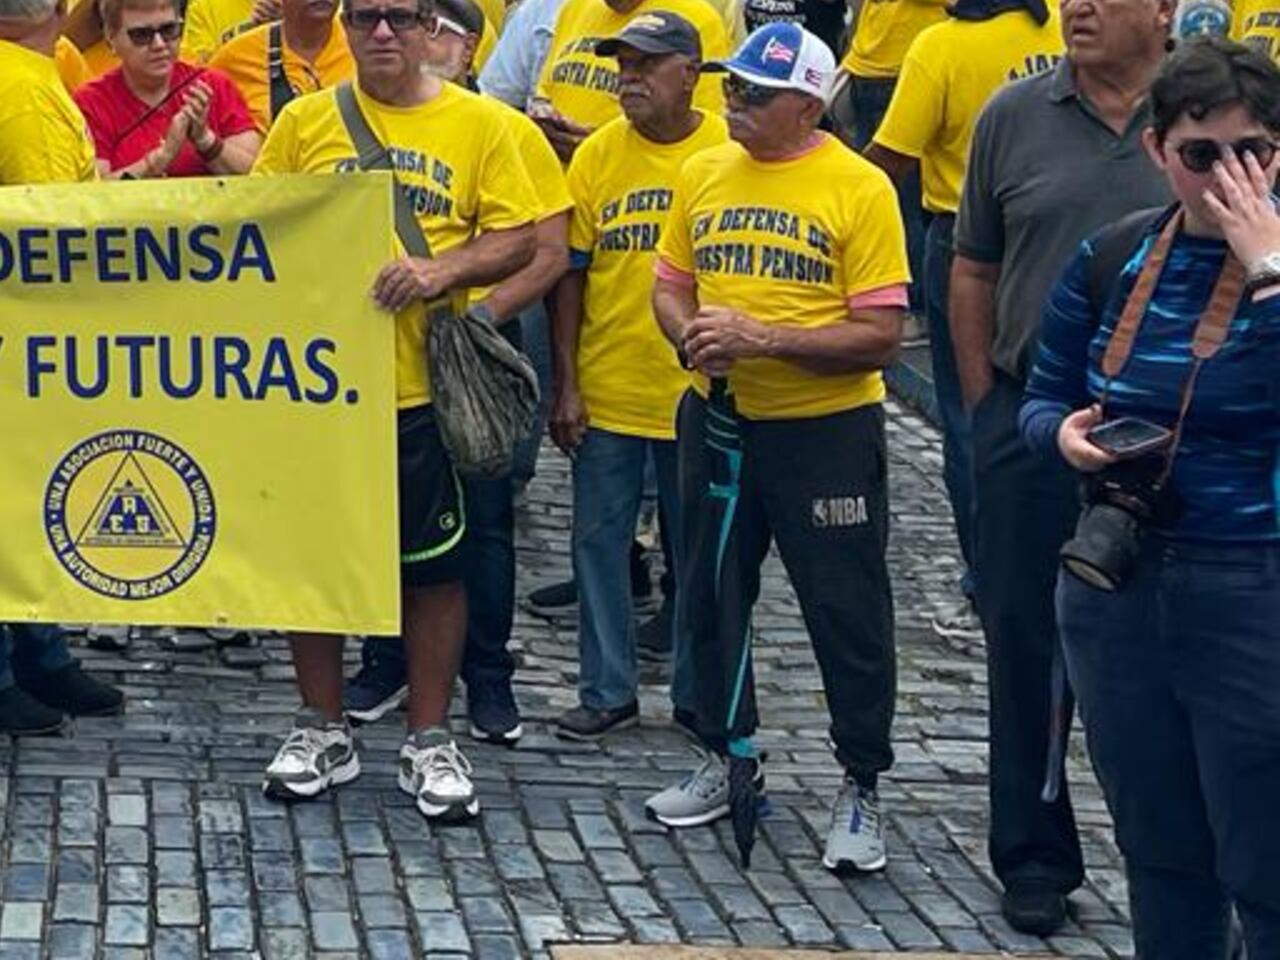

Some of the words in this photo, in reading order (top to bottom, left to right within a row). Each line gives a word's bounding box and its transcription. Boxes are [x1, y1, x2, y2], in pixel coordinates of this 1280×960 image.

[432, 158, 453, 191] DE
[719, 206, 800, 240] DEFENSA
[760, 244, 834, 283] PENSION
[27, 334, 360, 405] FUTURAS.
[137, 434, 189, 470] FUERTE
[184, 466, 199, 479] Y
[830, 496, 868, 526] NBA
